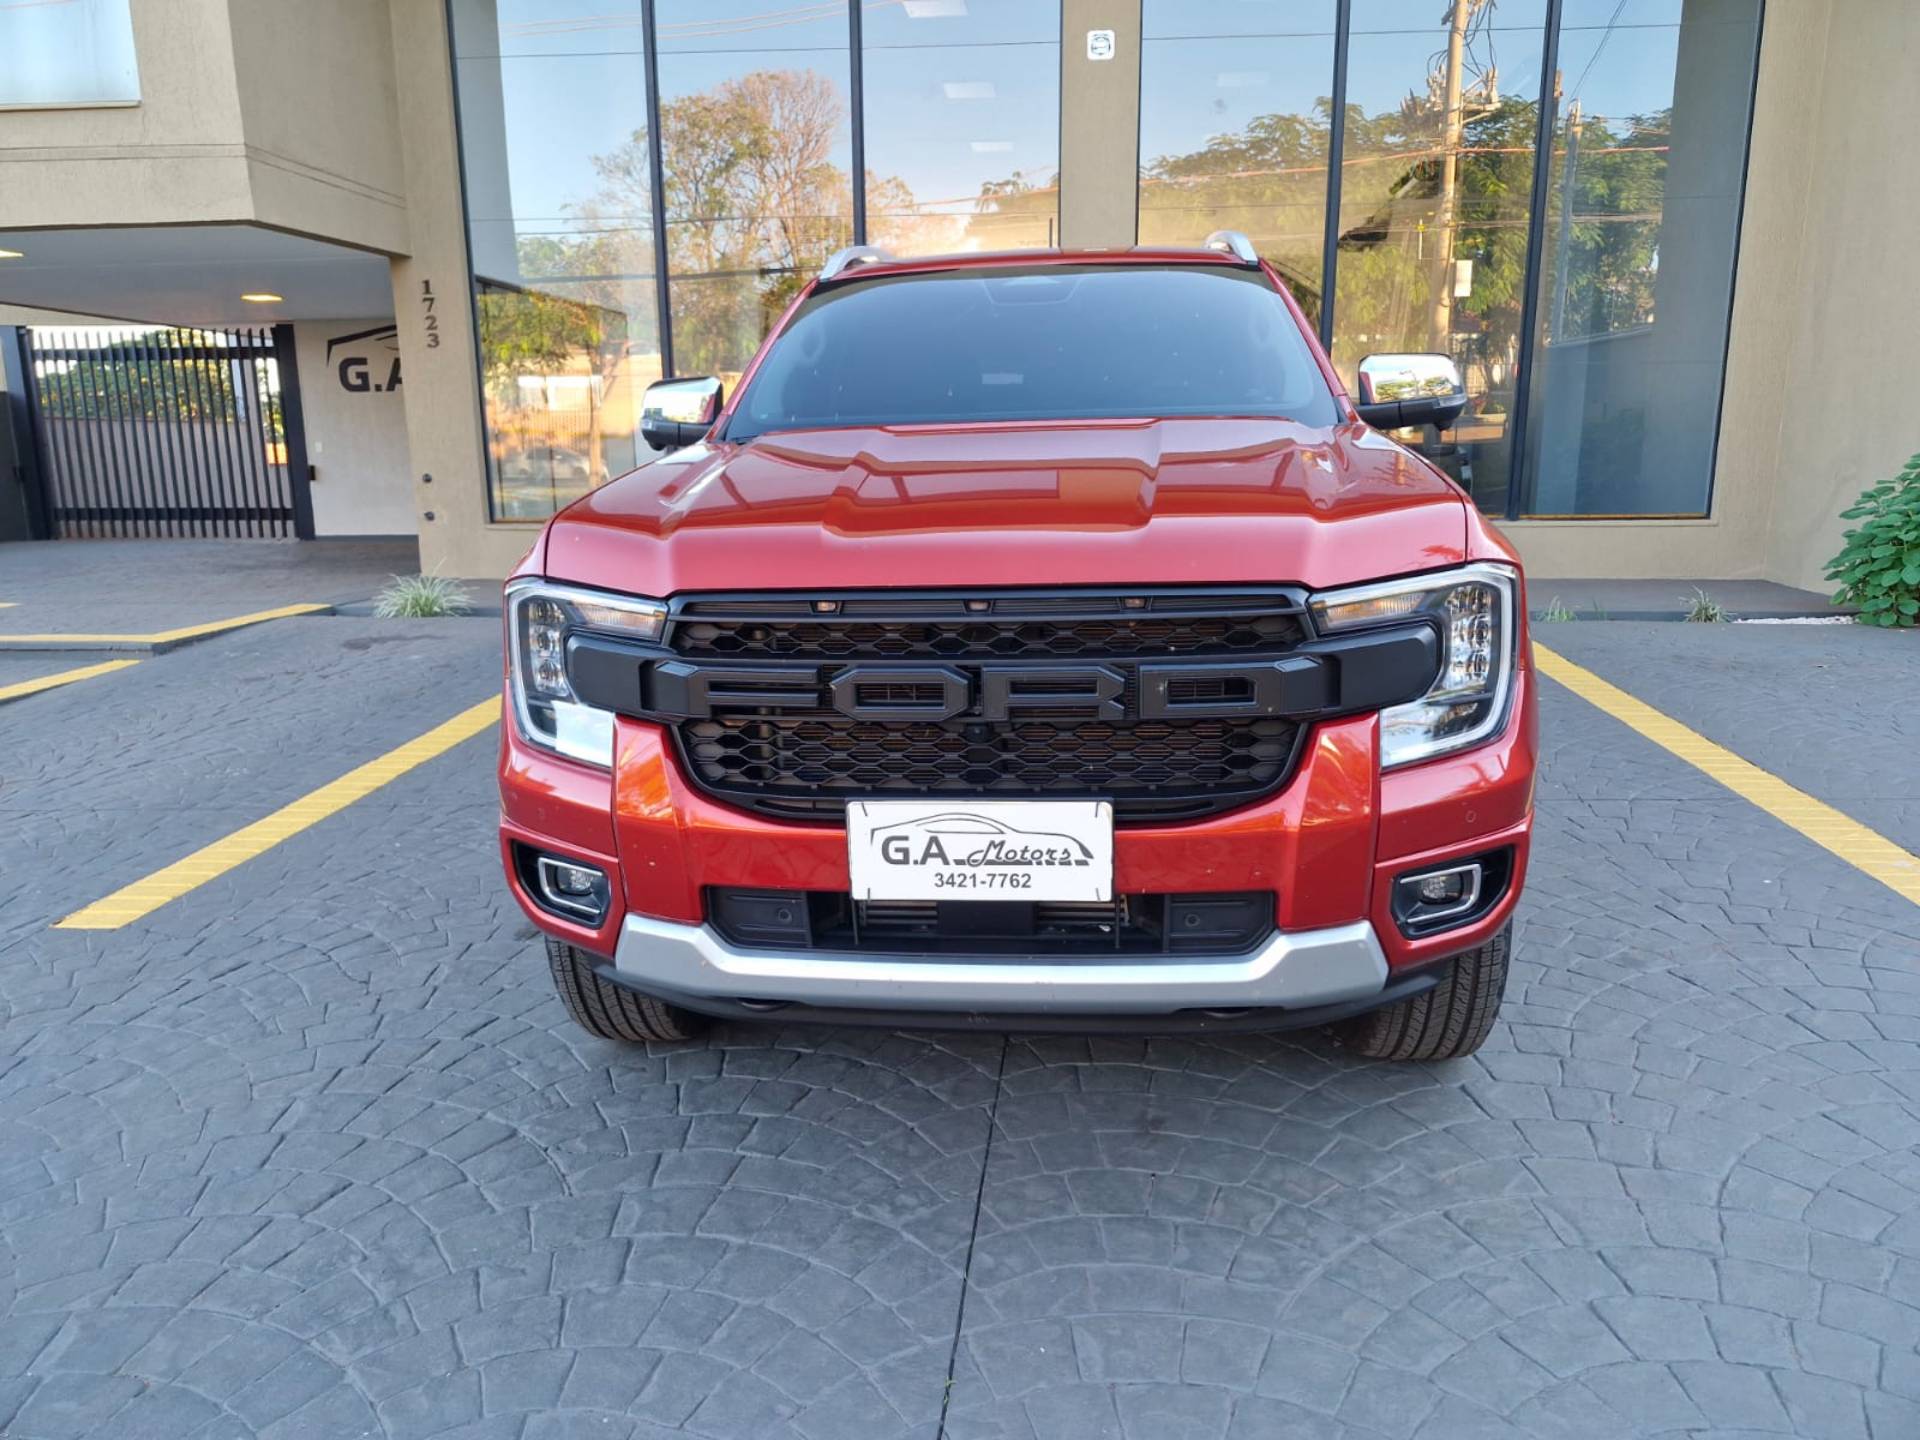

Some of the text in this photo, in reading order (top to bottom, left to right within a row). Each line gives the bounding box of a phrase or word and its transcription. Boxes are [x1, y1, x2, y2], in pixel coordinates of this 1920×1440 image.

[421, 279, 440, 348] 1723
[688, 660, 1282, 723] FORD
[881, 835, 1072, 868] G.A Motors
[934, 872, 1032, 889] 3421-7762
